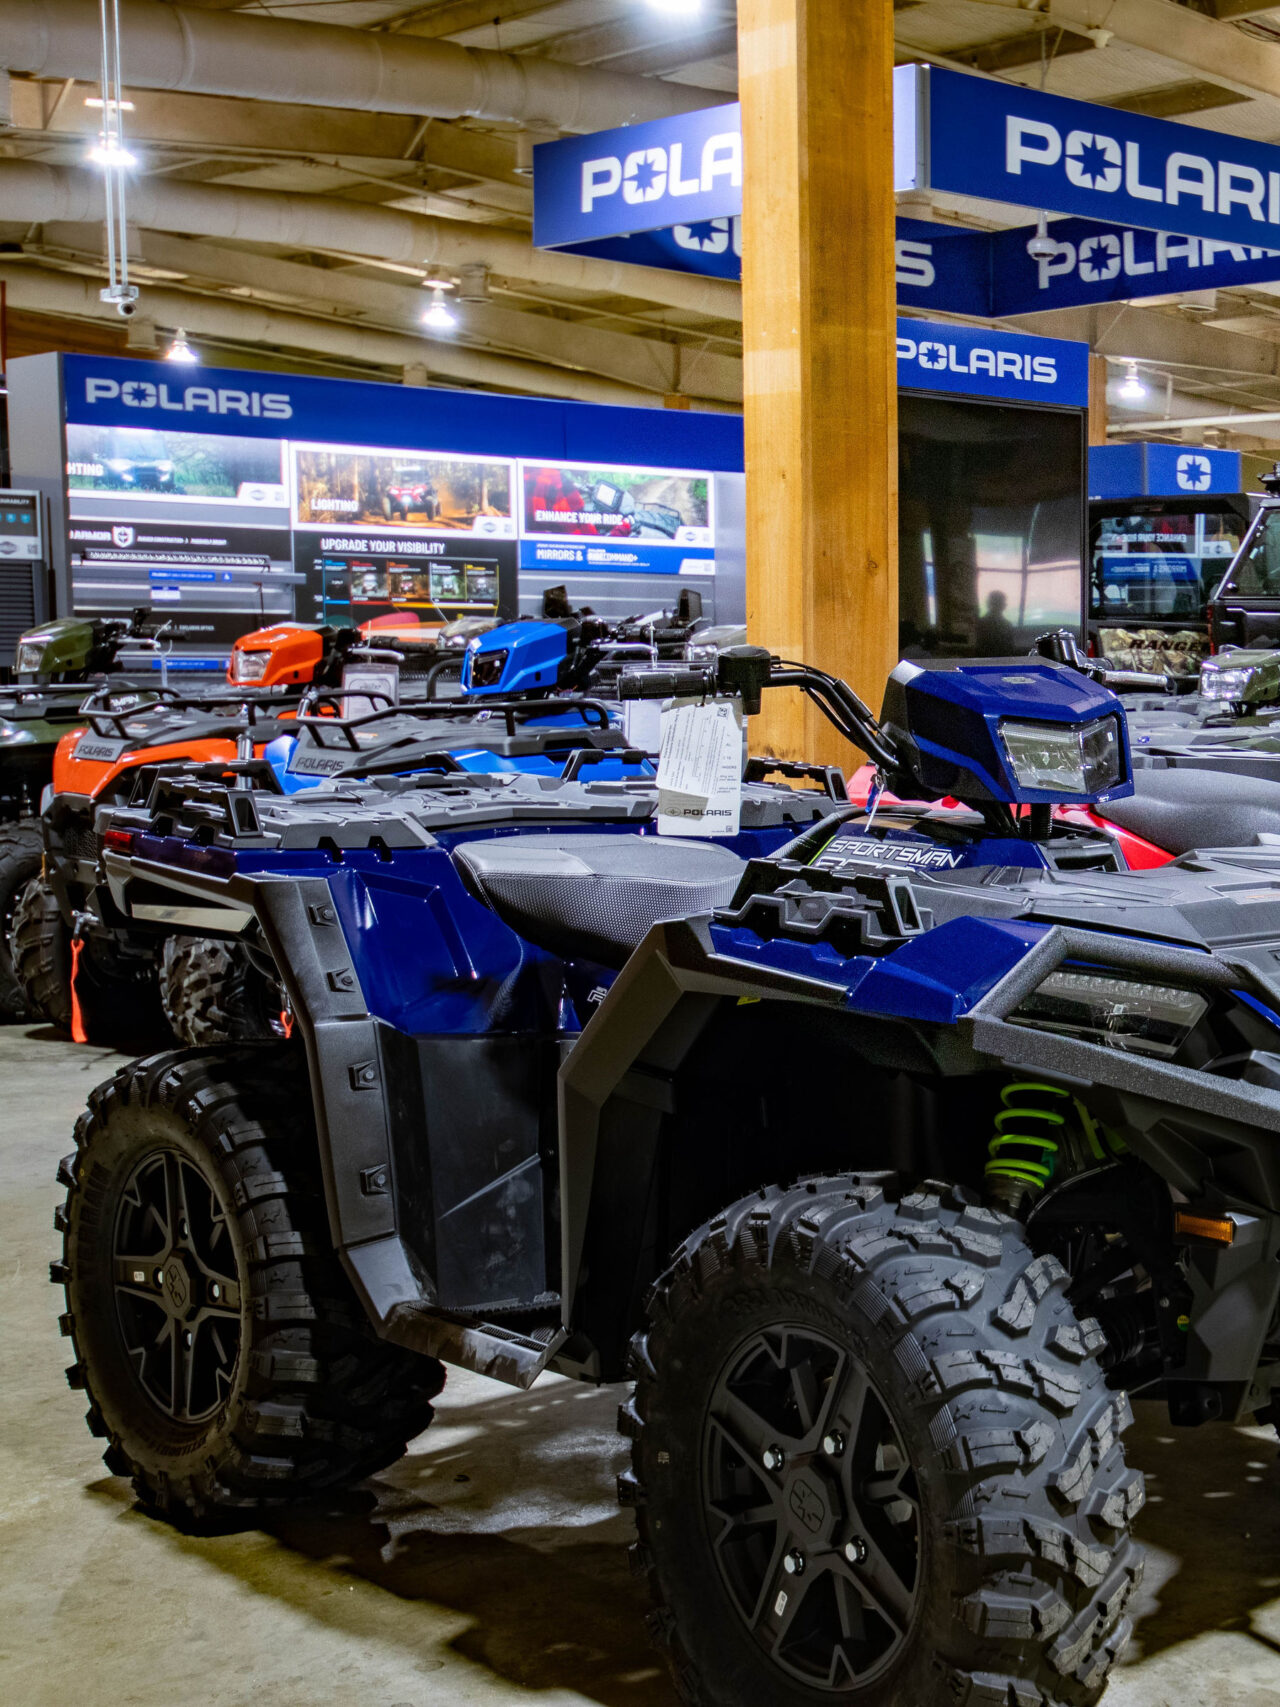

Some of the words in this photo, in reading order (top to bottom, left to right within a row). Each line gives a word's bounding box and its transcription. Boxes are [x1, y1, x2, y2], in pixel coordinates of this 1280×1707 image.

[581, 132, 742, 213] POLA
[896, 337, 1057, 384] POLARIS
[86, 377, 292, 419] POLARIS
[66, 462, 104, 476] HTING
[311, 499, 359, 513] LIGHTING
[535, 509, 578, 523] ENHANCE
[578, 511, 601, 524] YOUR
[602, 513, 623, 526] RIDE
[320, 538, 368, 552] UPGRADE
[370, 540, 396, 552] YOUR
[398, 541, 445, 554] VISIBILITY
[536, 549, 575, 561] MIRRORS
[576, 550, 583, 561] &
[1128, 638, 1202, 651] RANGE
[79, 744, 115, 757] POLARIS
[296, 757, 344, 771] POLARIS
[683, 809, 732, 817] POLARIS
[827, 839, 963, 868] SPORTSMAN
